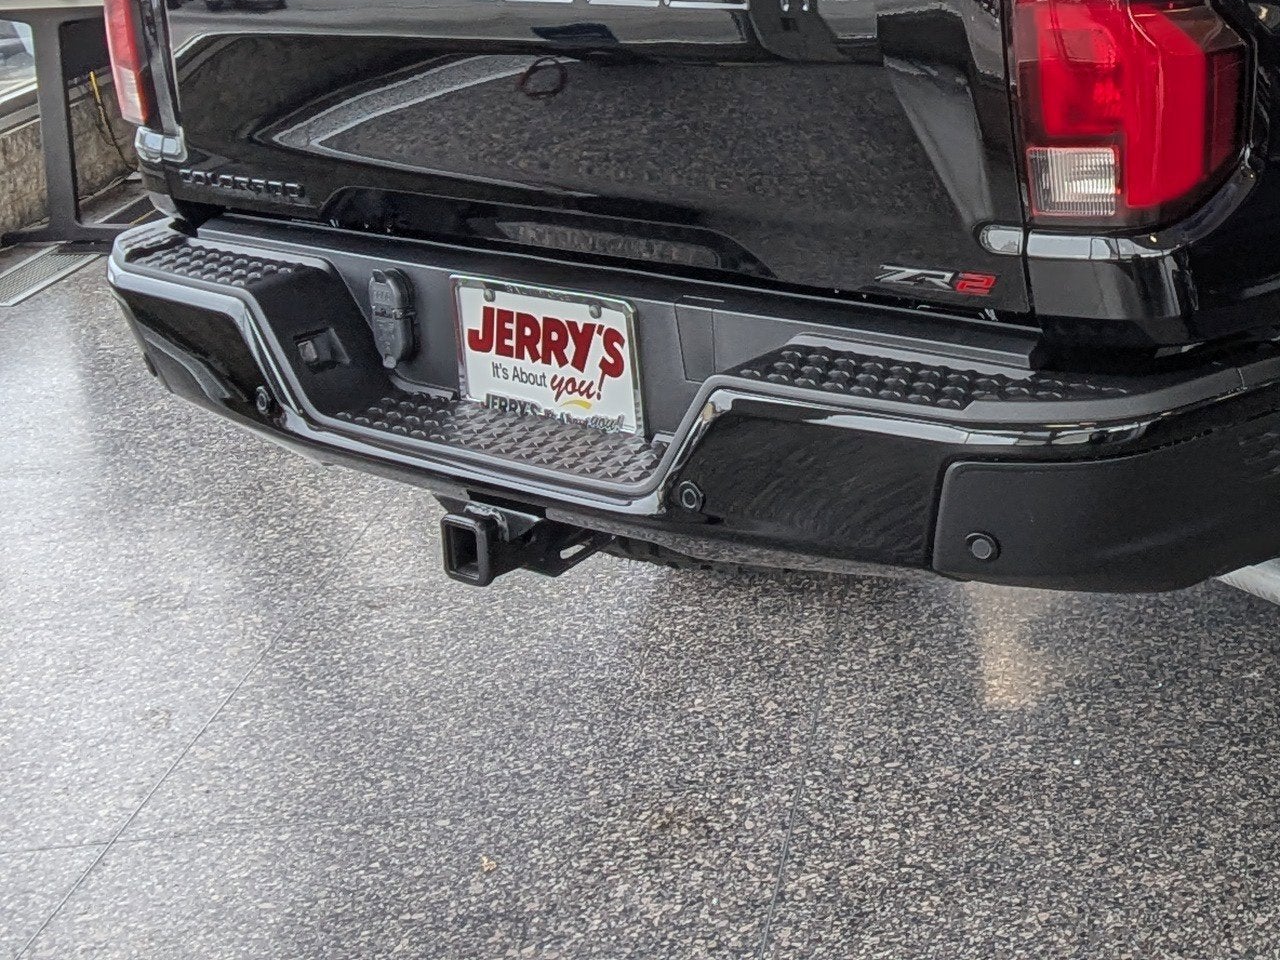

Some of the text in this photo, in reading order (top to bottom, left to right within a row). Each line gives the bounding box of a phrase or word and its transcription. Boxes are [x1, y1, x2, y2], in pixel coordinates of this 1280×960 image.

[873, 262, 997, 297] ZR2
[467, 305, 626, 378] JERRY'S
[491, 361, 607, 403] It's About you!
